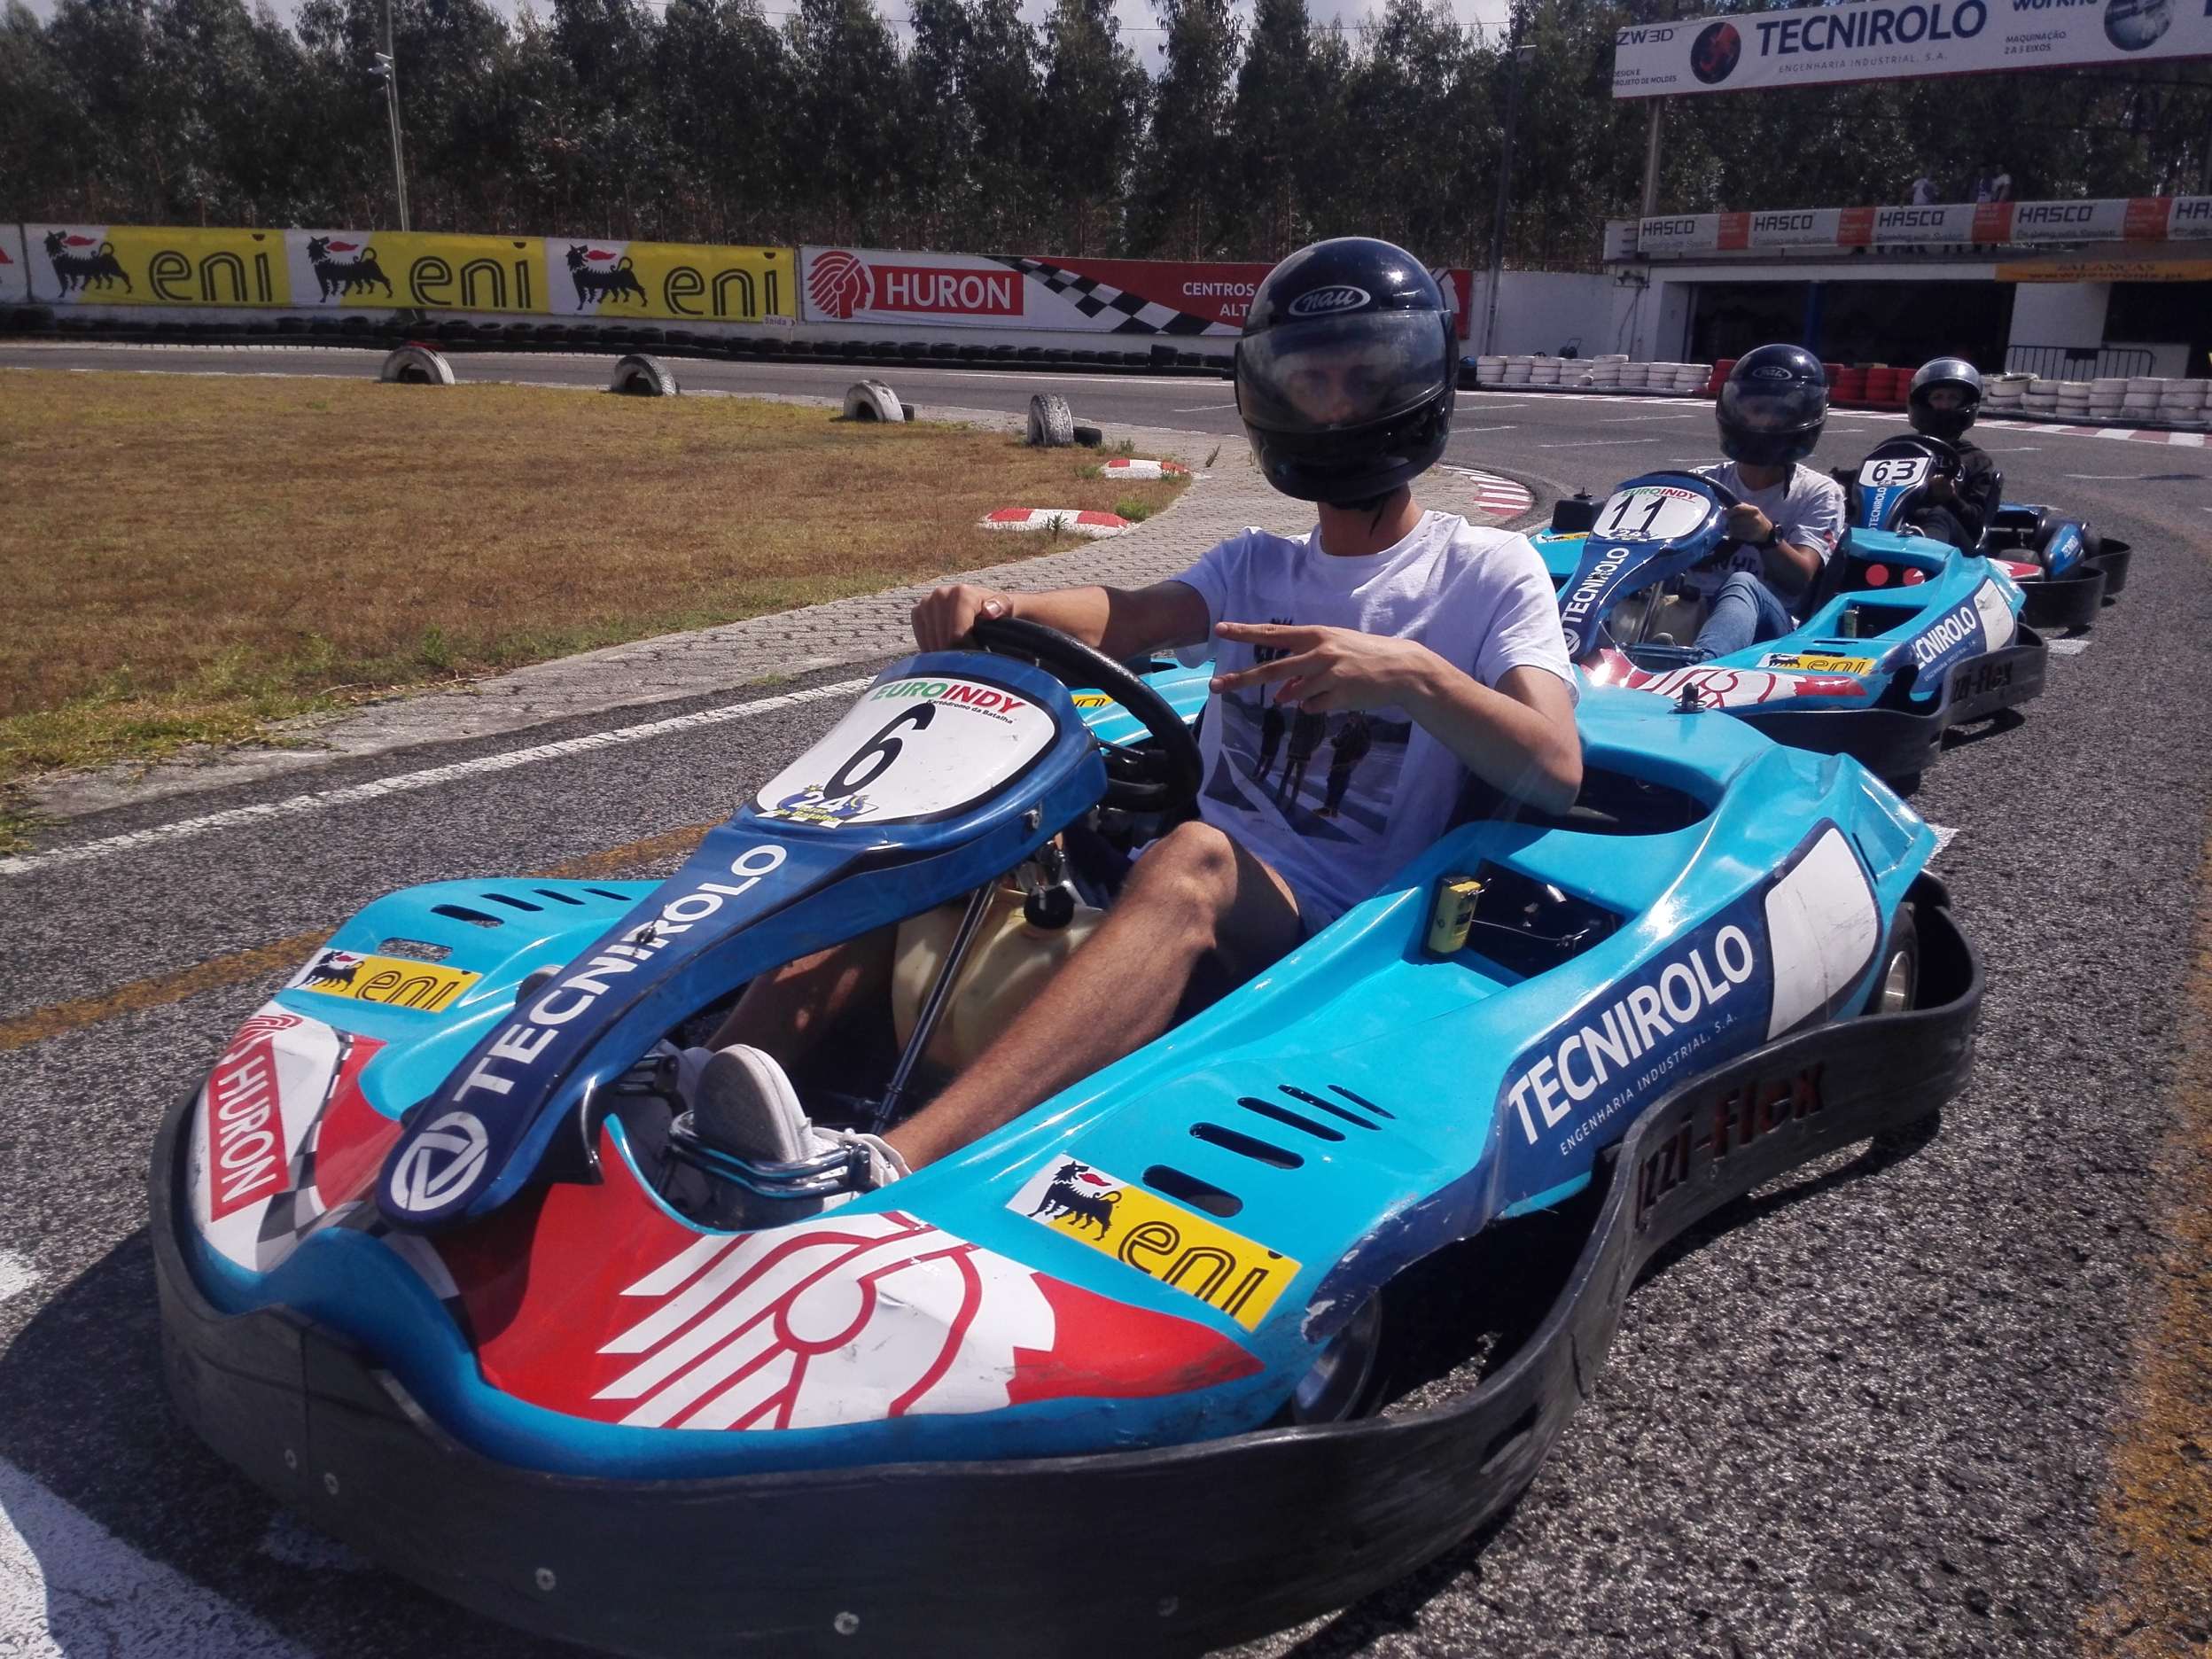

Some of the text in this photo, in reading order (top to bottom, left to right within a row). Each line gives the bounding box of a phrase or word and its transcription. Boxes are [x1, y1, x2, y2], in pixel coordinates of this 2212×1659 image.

[1616, 28, 1674, 46] ZW3D
[1756, 0, 1987, 56] TECNIROLO
[1779, 60, 1846, 74] ENGENHARIA
[1925, 52, 1948, 62] S.A.
[2026, 43, 2052, 53] EIXOS
[1641, 220, 1695, 237] HASCO
[1753, 214, 1814, 232] HASCO
[1878, 210, 1946, 228] HASCO
[2018, 206, 2094, 223] HASCO
[149, 233, 272, 302] eni
[409, 241, 531, 308] eni
[664, 252, 779, 315] eni
[885, 272, 1012, 309] HURON
[1183, 282, 1256, 297] CENTROS
[1219, 303, 1250, 317] ALT
[1872, 460, 1918, 482] 63
[1608, 495, 1668, 533] 11
[1561, 548, 1630, 623] TECNIROLO
[1808, 658, 1868, 674] eni
[870, 682, 1026, 714] EUROINDY
[982, 708, 1014, 725] Batalha
[823, 702, 937, 799] 6
[788, 791, 854, 813] 24
[452, 844, 787, 1102] TECNIROLO
[354, 970, 471, 1011] eni
[1508, 924, 1754, 1145] TECNIROLO
[1560, 1087, 1635, 1156] ENGENHARIA
[1715, 1013, 1738, 1034] S.A.
[218, 1055, 277, 1203] HURON
[1118, 1219, 1283, 1318] eni
